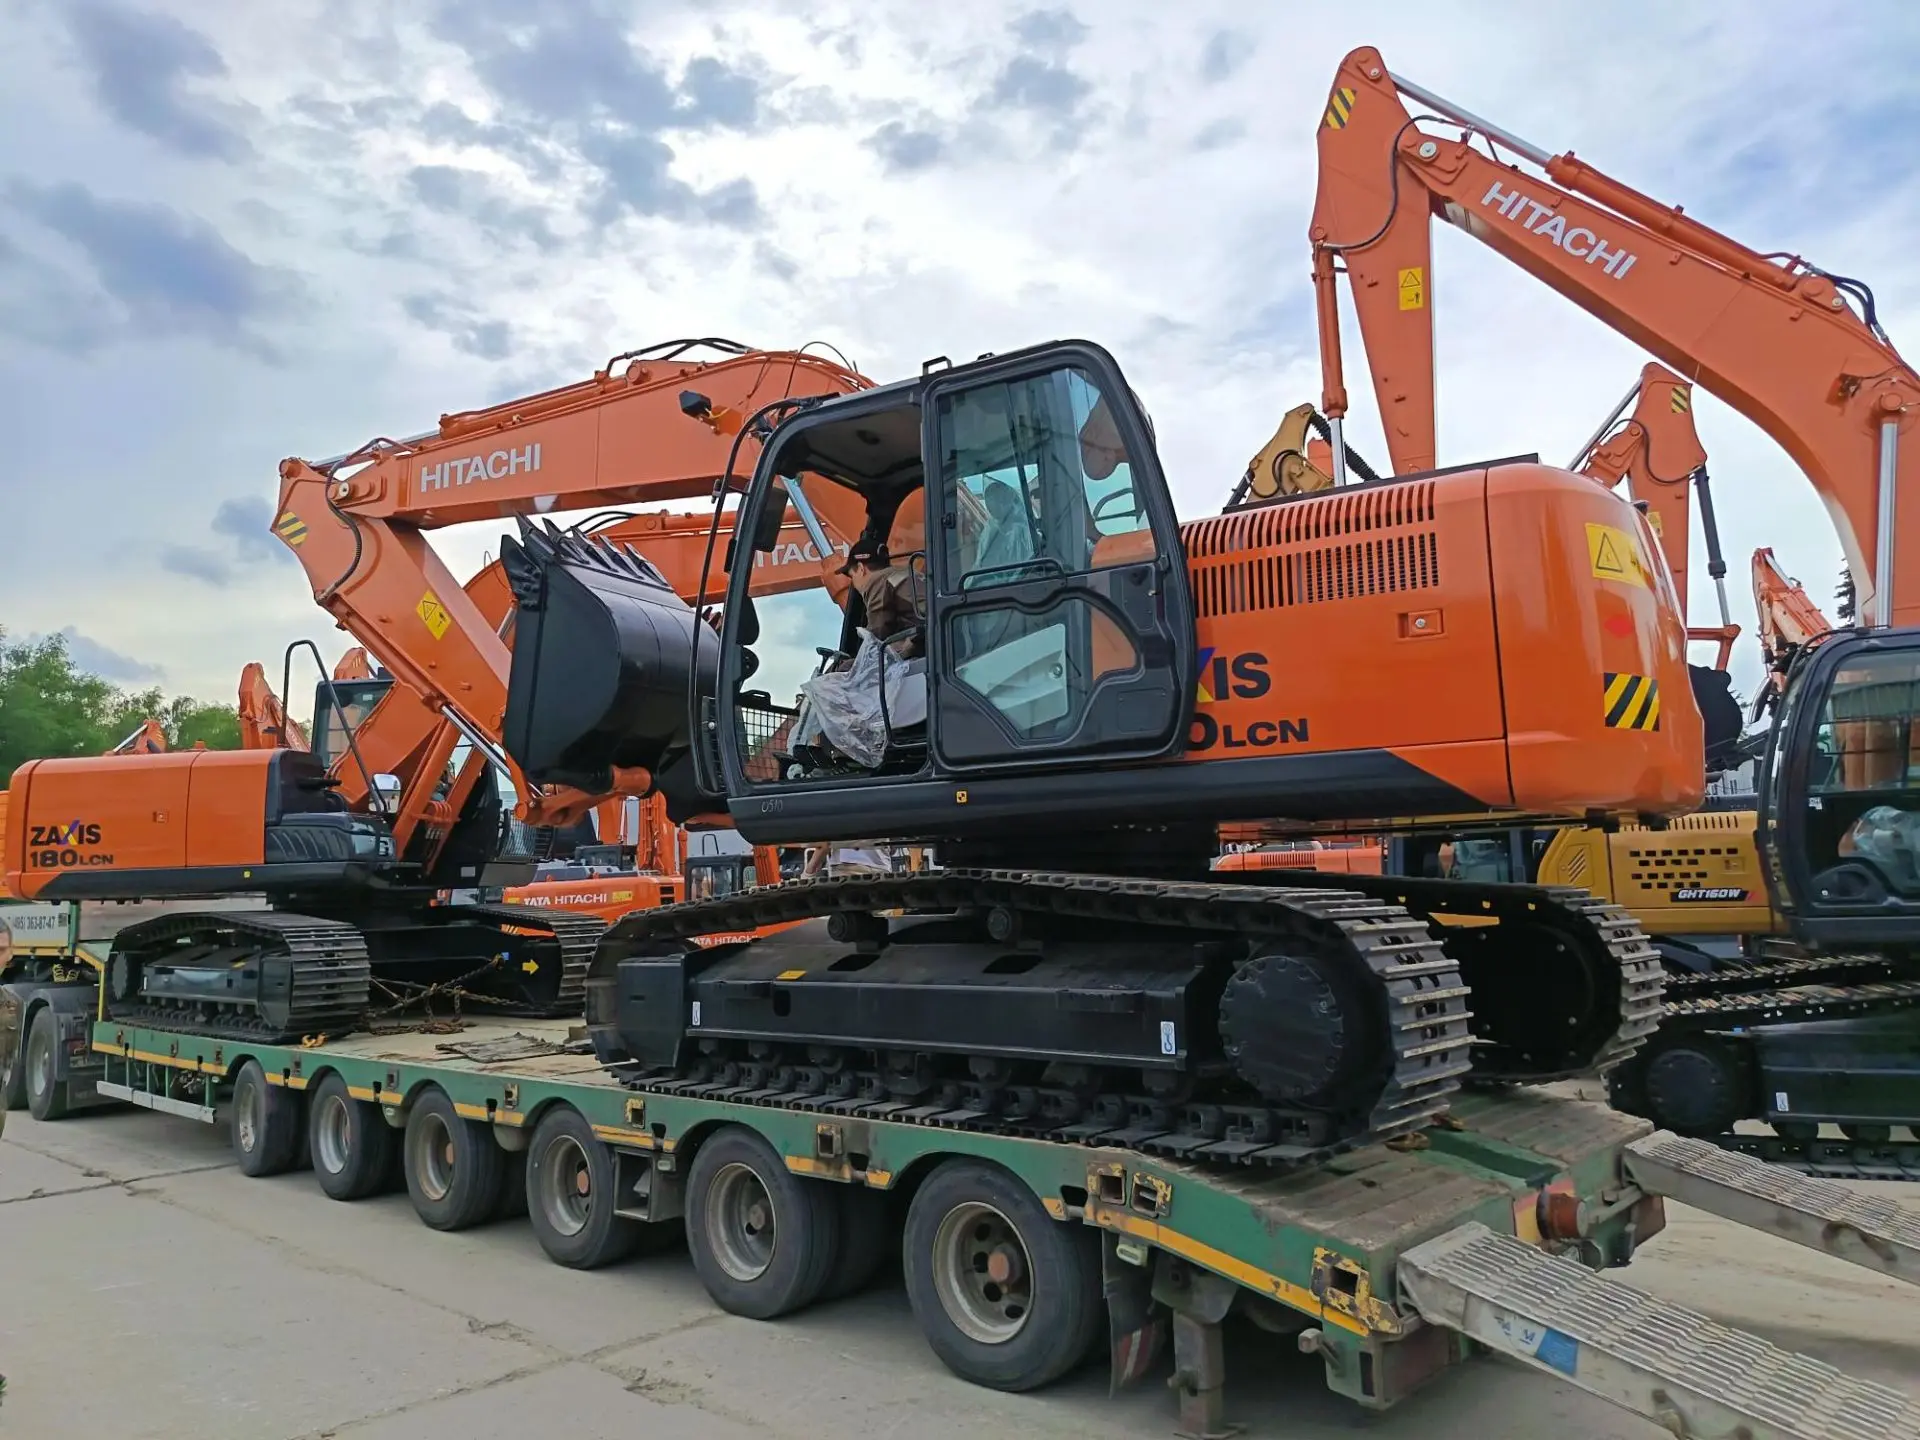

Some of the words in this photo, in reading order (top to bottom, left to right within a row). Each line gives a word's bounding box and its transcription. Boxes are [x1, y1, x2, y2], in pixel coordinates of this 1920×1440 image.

[1480, 180, 1638, 280] HITACHI
[420, 442, 541, 493] HITACHI
[752, 538, 850, 569] ITACH
[29, 819, 102, 846] ZAXIS
[523, 896, 550, 906] TATA
[554, 893, 607, 905] HITACHI
